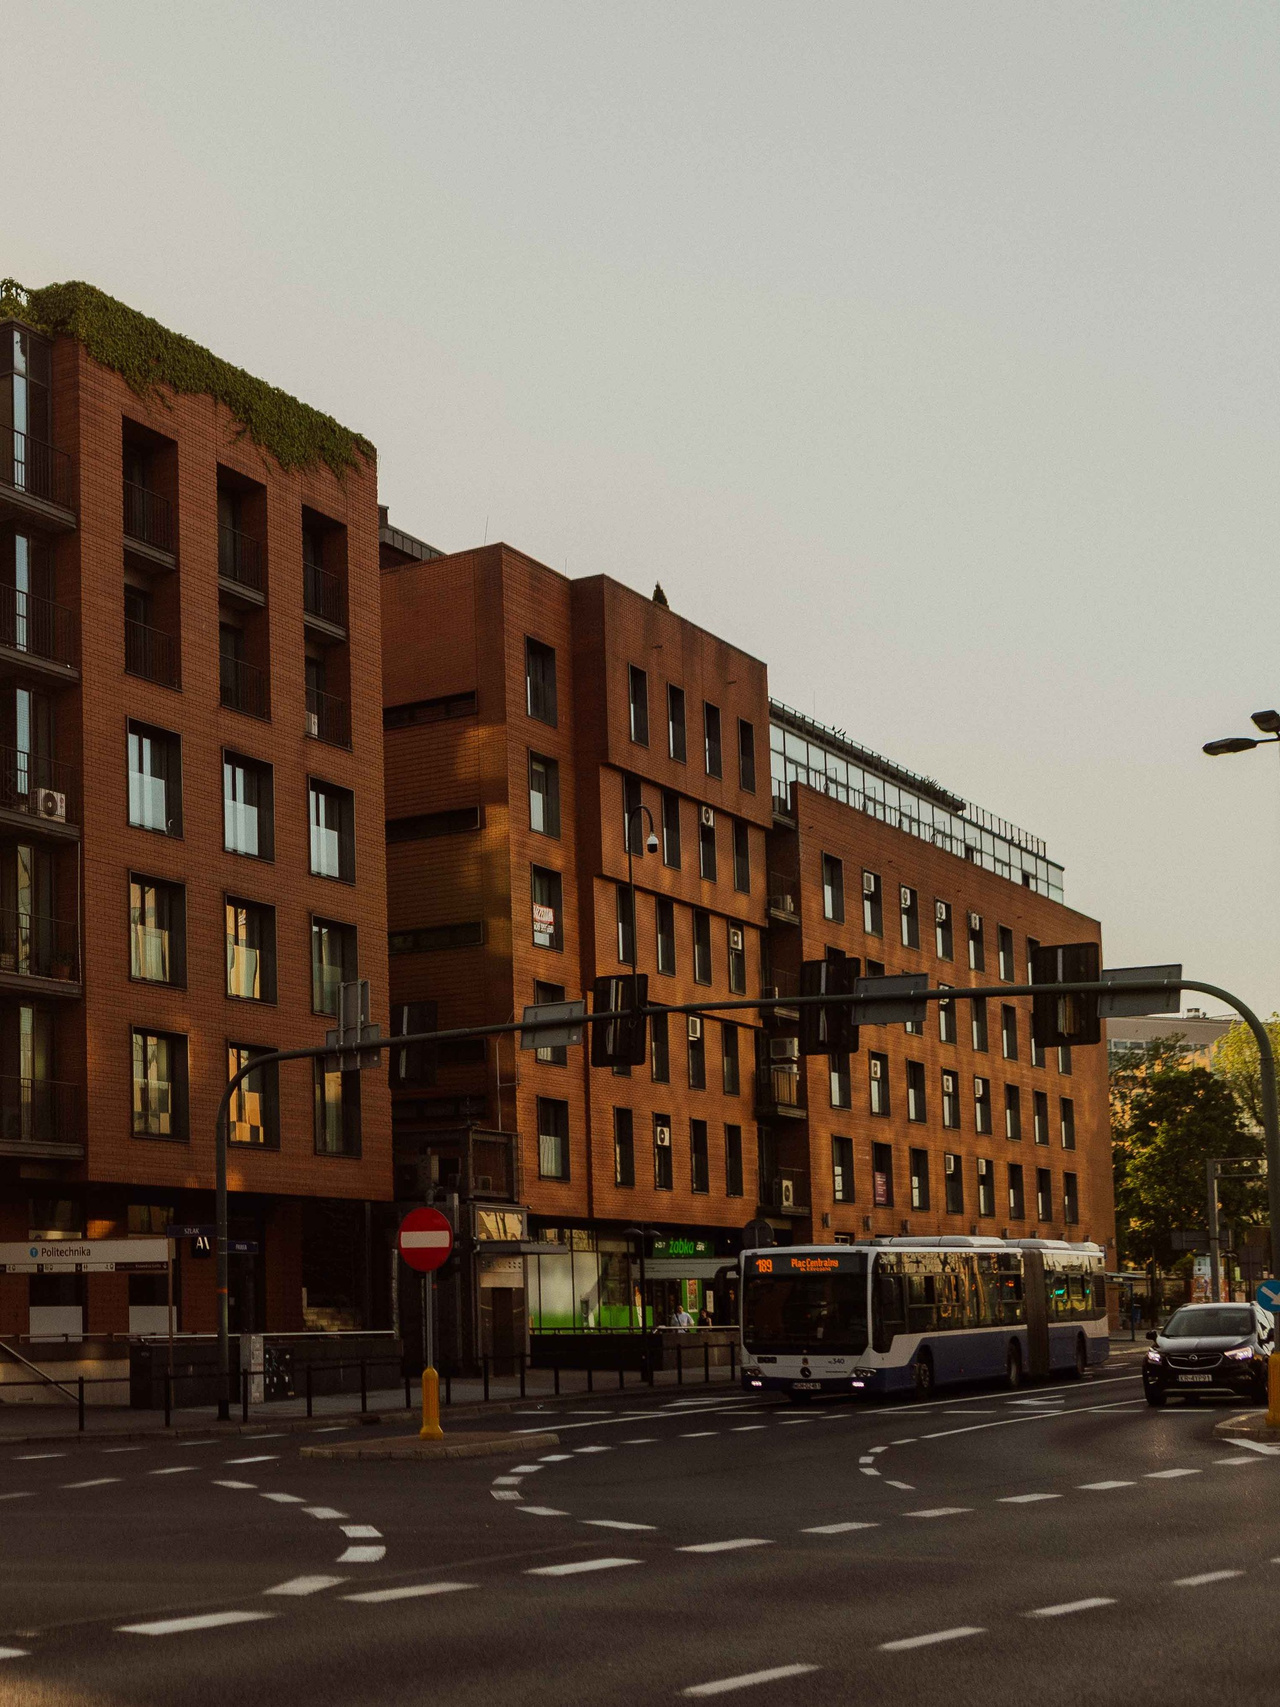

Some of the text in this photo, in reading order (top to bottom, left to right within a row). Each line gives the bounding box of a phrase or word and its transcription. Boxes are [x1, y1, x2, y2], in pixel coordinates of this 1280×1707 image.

[41, 1246, 91, 1258] Politechnika
[669, 1237, 695, 1254] żabka
[755, 1258, 773, 1273] 189
[790, 1257, 806, 1268] Plac
